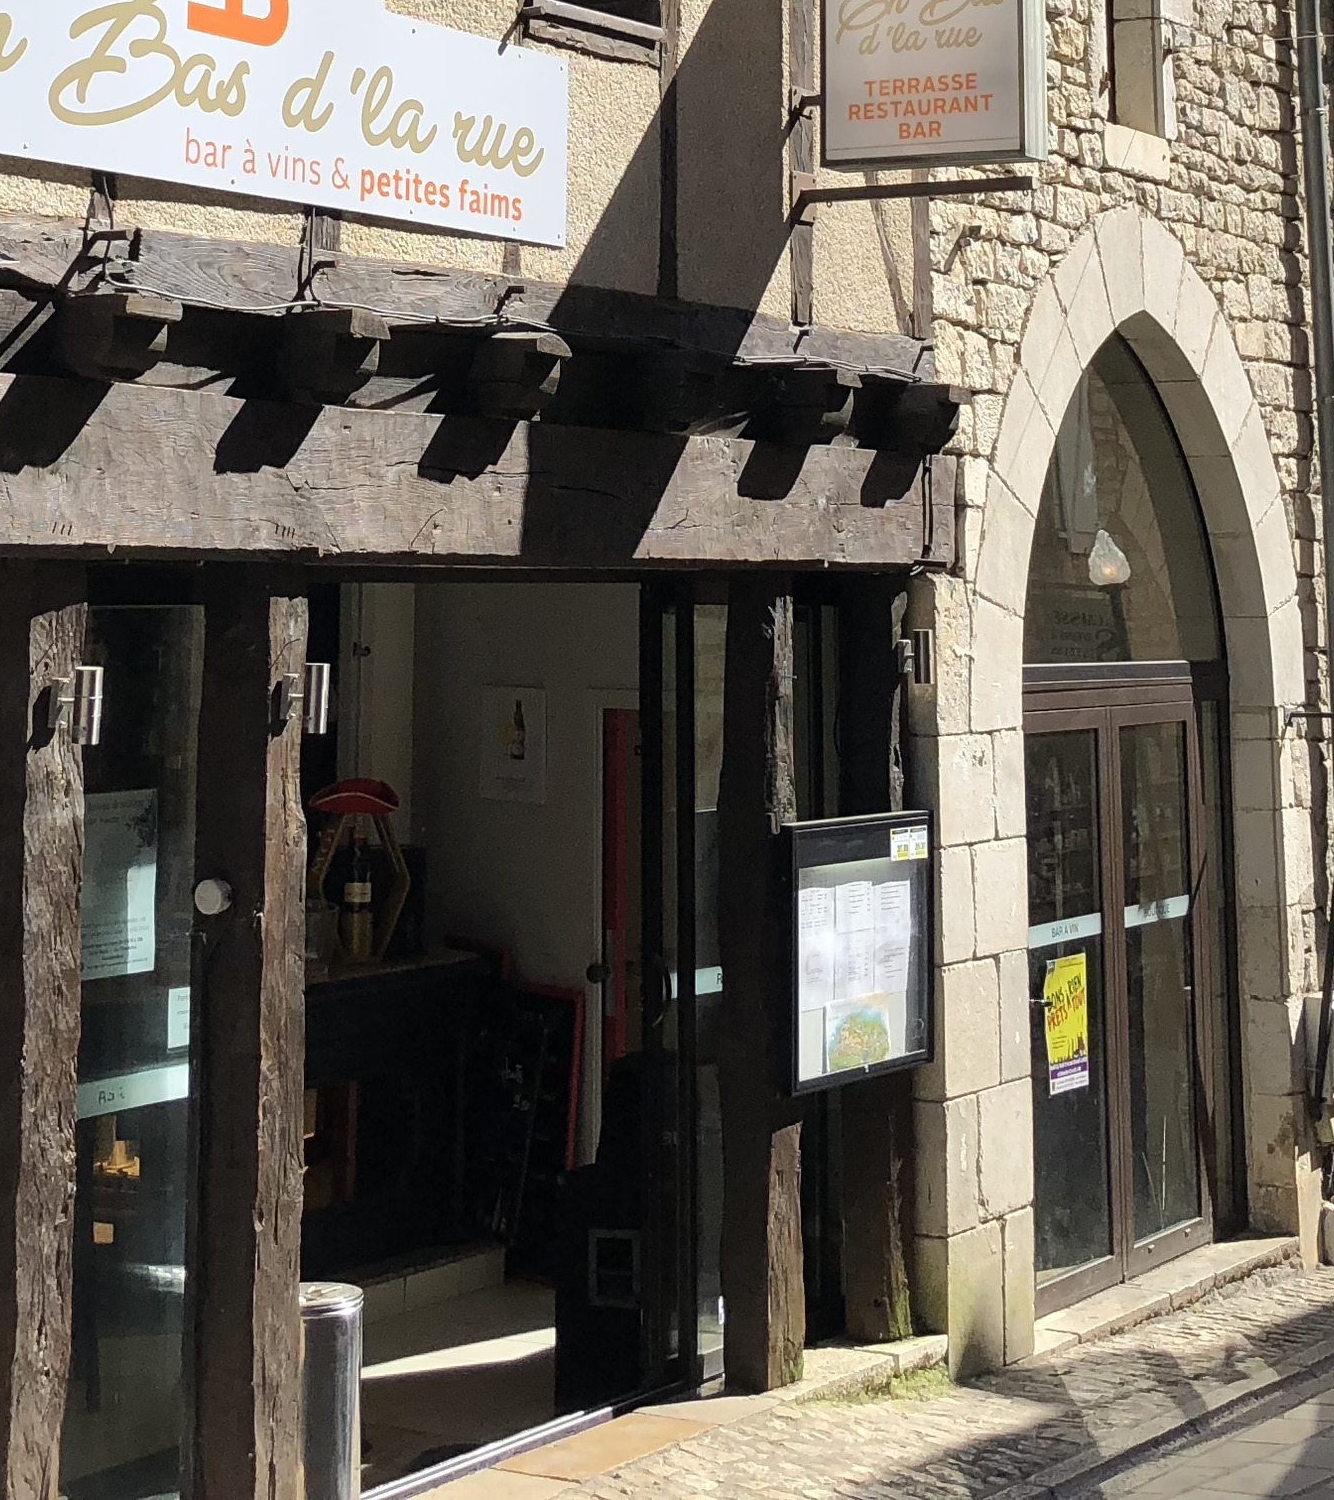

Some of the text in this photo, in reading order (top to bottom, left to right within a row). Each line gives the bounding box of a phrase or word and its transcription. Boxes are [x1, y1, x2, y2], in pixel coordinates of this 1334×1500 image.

[935, 25, 983, 49] rue
[864, 72, 977, 98] TERRASSE
[848, 94, 994, 121] RESTAURANT
[898, 119, 942, 140] BAR
[452, 111, 544, 177] rue
[185, 127, 523, 221] bar à vins & petites faims
[1052, 926, 1063, 938] BAR
